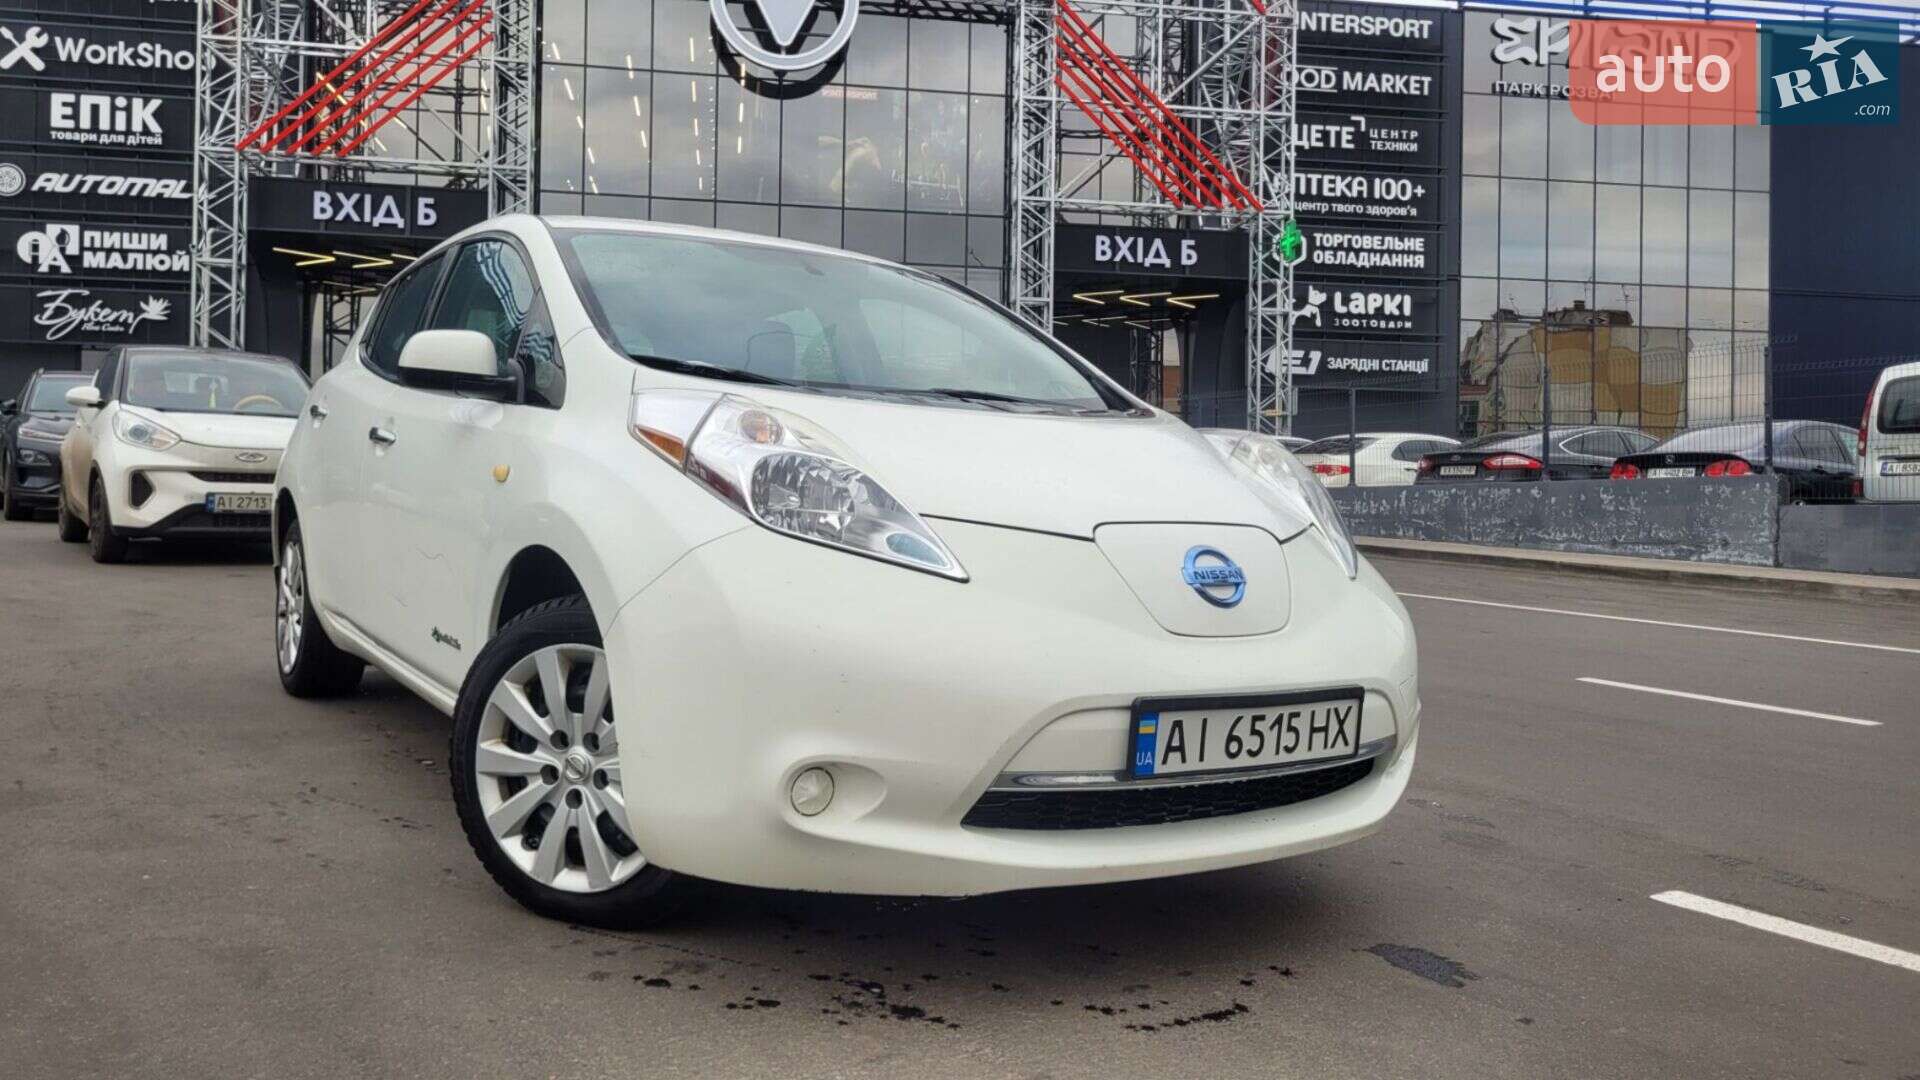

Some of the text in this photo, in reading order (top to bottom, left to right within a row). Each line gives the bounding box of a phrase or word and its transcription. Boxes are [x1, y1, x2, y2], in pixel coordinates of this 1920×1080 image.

[1280, 67, 1432, 96] OOD MARKET
[1495, 80, 1546, 96] ПАРК
[50, 130, 163, 146] товари для дітей
[1369, 128, 1418, 140] ЦЕНТР
[1370, 140, 1418, 152] ТЕХНІКИ
[312, 190, 438, 229] ВХІД Б
[1294, 201, 1329, 214] центр
[1331, 203, 1364, 214] твого
[83, 230, 168, 250] ПИШИ
[1314, 232, 1425, 252] ТОРГОВЕЛЬНЕ
[1095, 234, 1199, 269] ВХІД Б
[1313, 250, 1425, 269] ОБЛАДНАННЯ
[83, 250, 190, 272] МАЛЮЙ
[1334, 318, 1412, 329] ЗООТОВАРИ
[1327, 357, 1429, 374] ЗАРЯДНІ СТАНЦІЇ
[217, 496, 267, 509] AI 2713
[1193, 569, 1243, 581] NISSAN
[1136, 751, 1153, 766] UA
